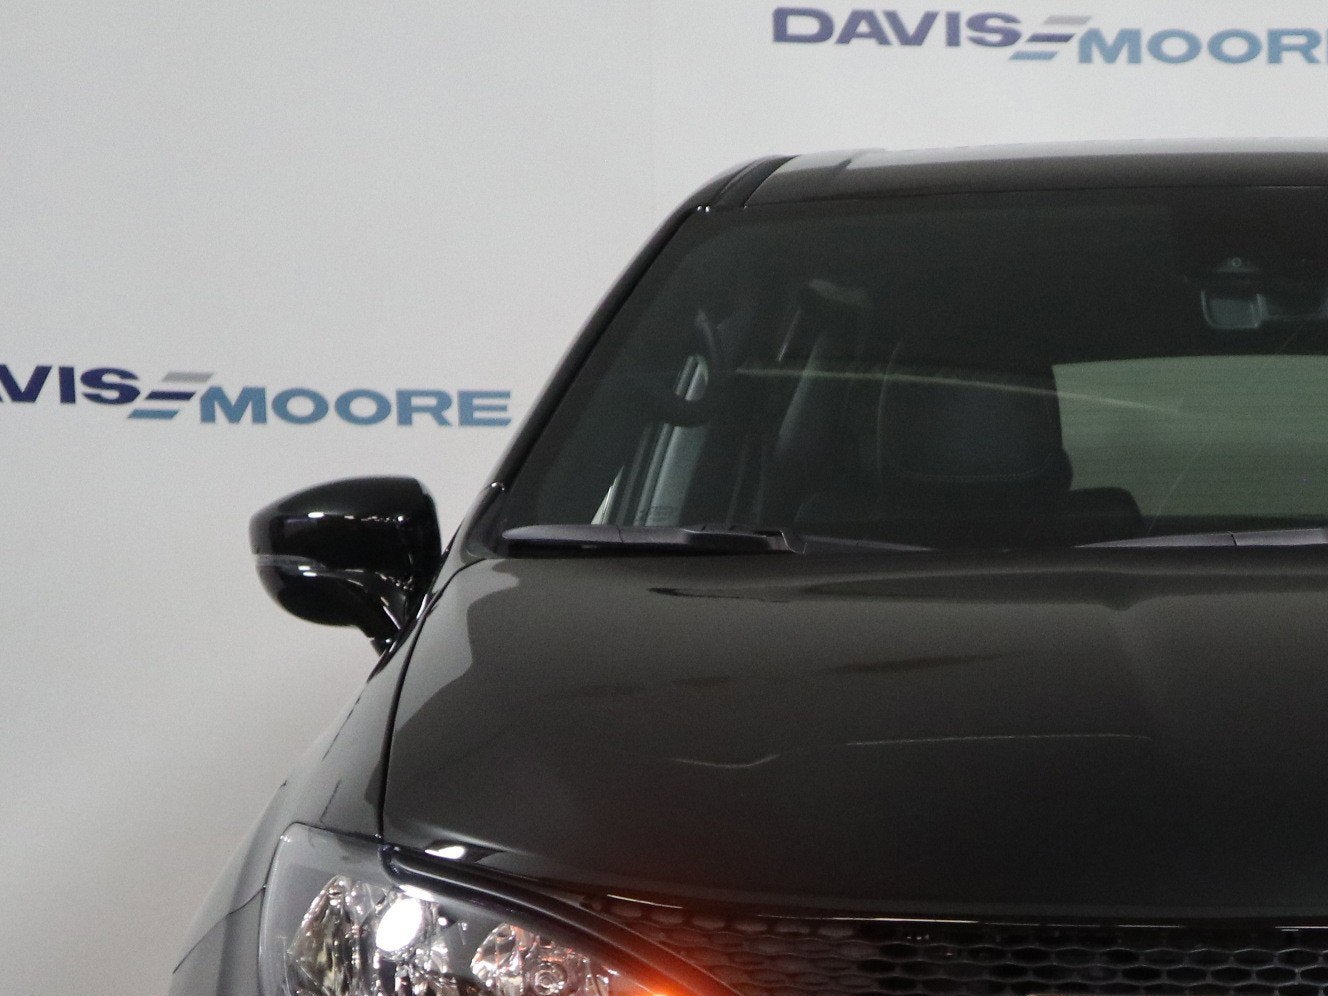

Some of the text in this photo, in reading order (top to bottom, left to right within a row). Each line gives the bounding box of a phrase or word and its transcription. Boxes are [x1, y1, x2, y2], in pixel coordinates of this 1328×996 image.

[772, 6, 1021, 47] DAVIS
[0, 364, 512, 427] VIS MOORE
